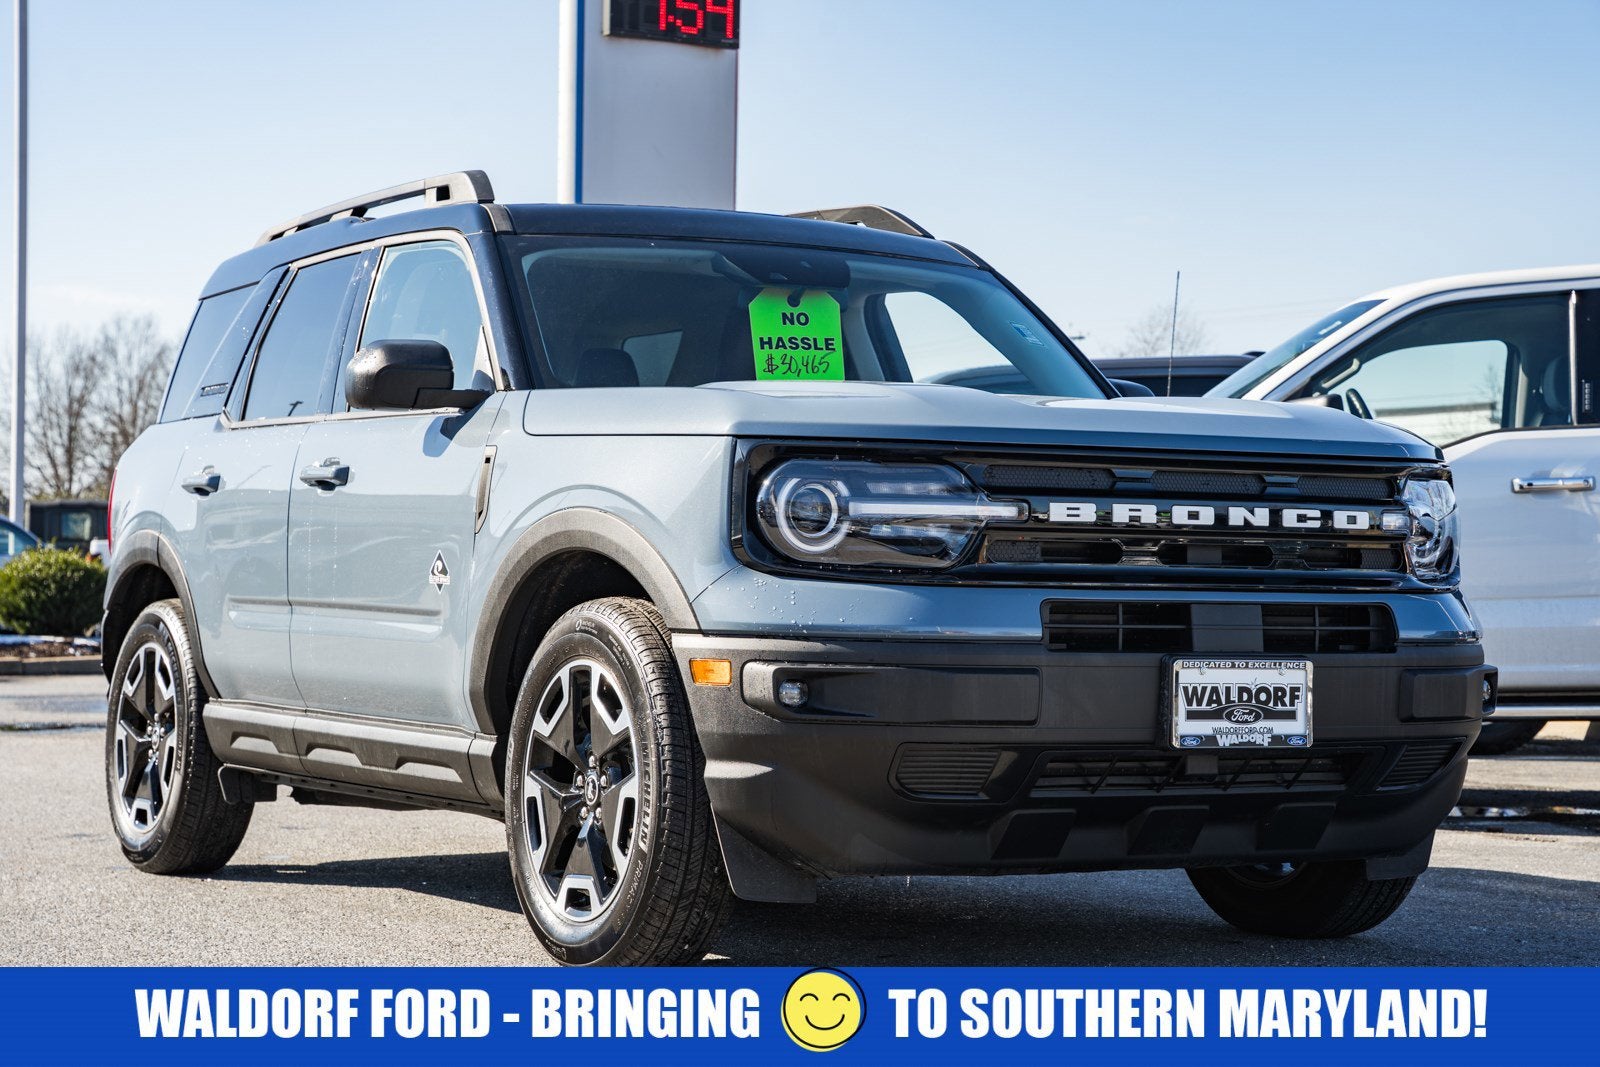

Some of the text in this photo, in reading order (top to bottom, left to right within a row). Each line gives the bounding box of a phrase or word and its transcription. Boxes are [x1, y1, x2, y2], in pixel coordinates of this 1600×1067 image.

[781, 312, 810, 326] NO
[759, 336, 836, 351] HASSLE
[763, 352, 835, 377] $30,465
[1049, 502, 1370, 530] BRONCO
[1248, 661, 1306, 669] EXCELLENCE
[1181, 685, 1301, 708] WALDORF
[1231, 708, 1256, 721] Ford
[1216, 733, 1272, 747] WALDORF
